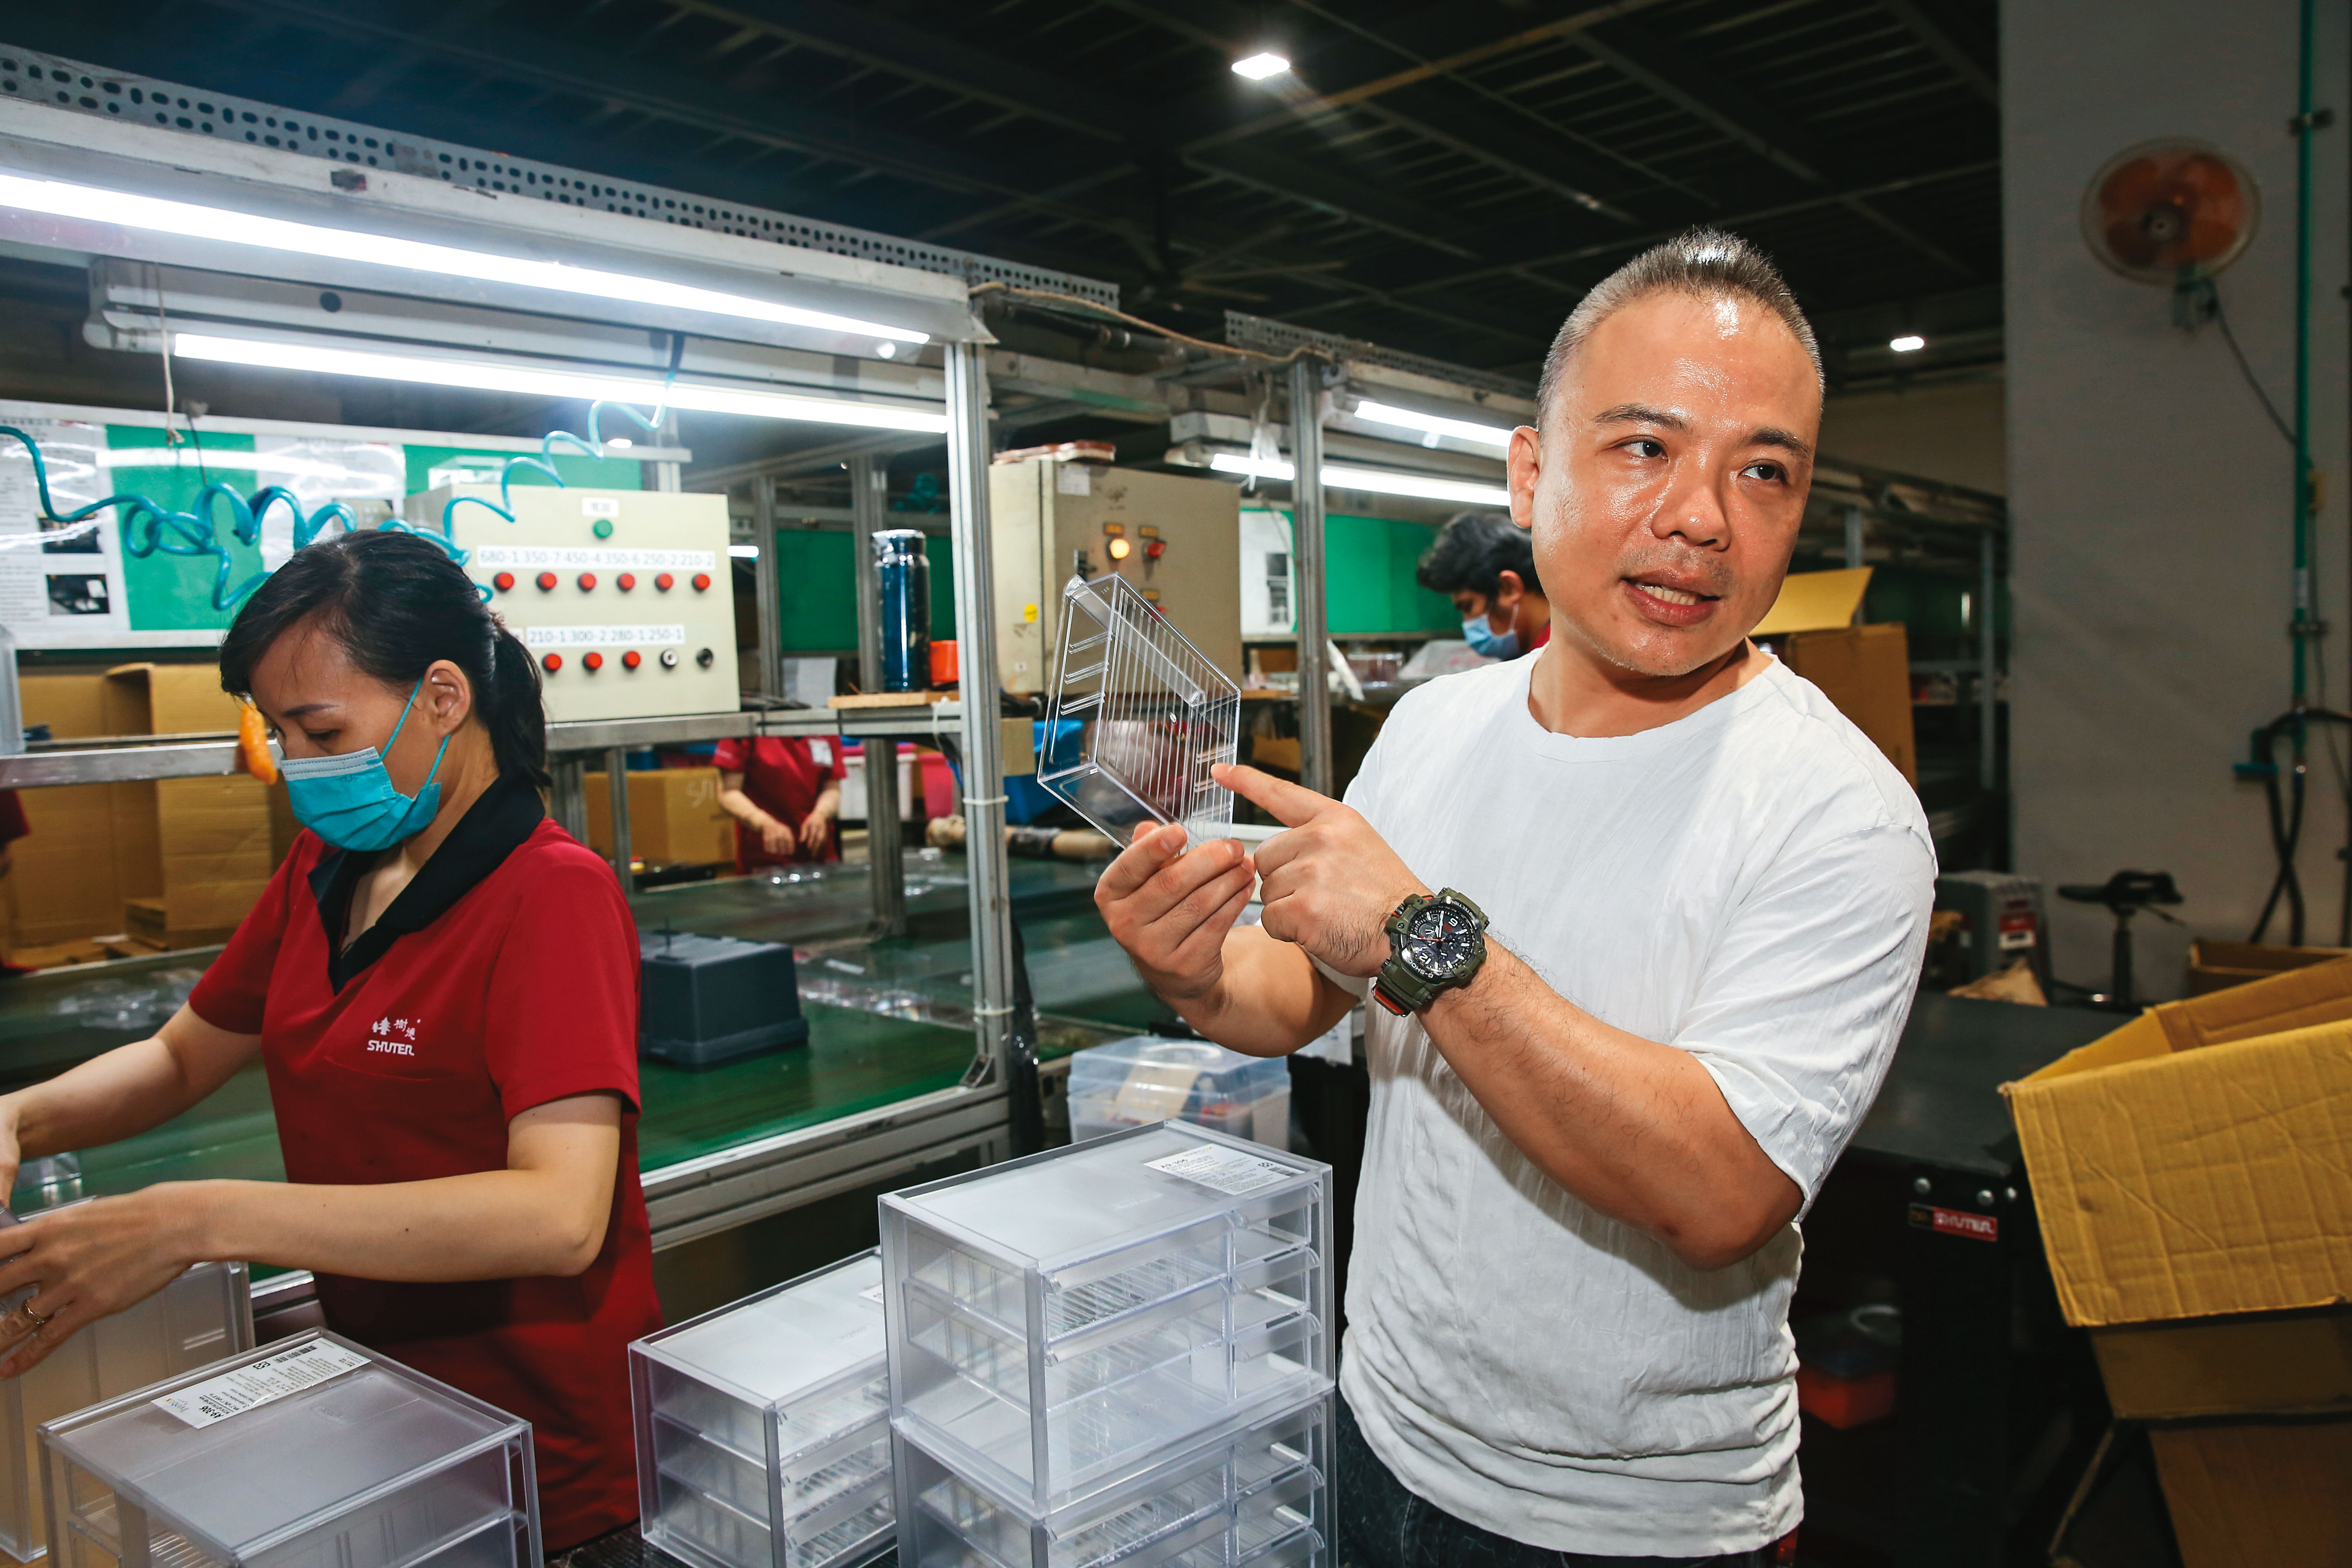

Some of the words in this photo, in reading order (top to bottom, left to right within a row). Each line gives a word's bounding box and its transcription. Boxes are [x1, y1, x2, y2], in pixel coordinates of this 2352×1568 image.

[480, 549, 518, 563] 680-1
[523, 550, 560, 563] 350-7
[564, 551, 600, 564] 450-4
[643, 553, 677, 565] 250-2
[681, 553, 712, 566] 210-2
[529, 630, 566, 643] 210-1
[571, 629, 606, 642] 300-2
[649, 628, 682, 640] 250-1
[1419, 952, 1432, 964] 12
[367, 1039, 415, 1056] SHUTER
[199, 1405, 224, 1418] A9-306
